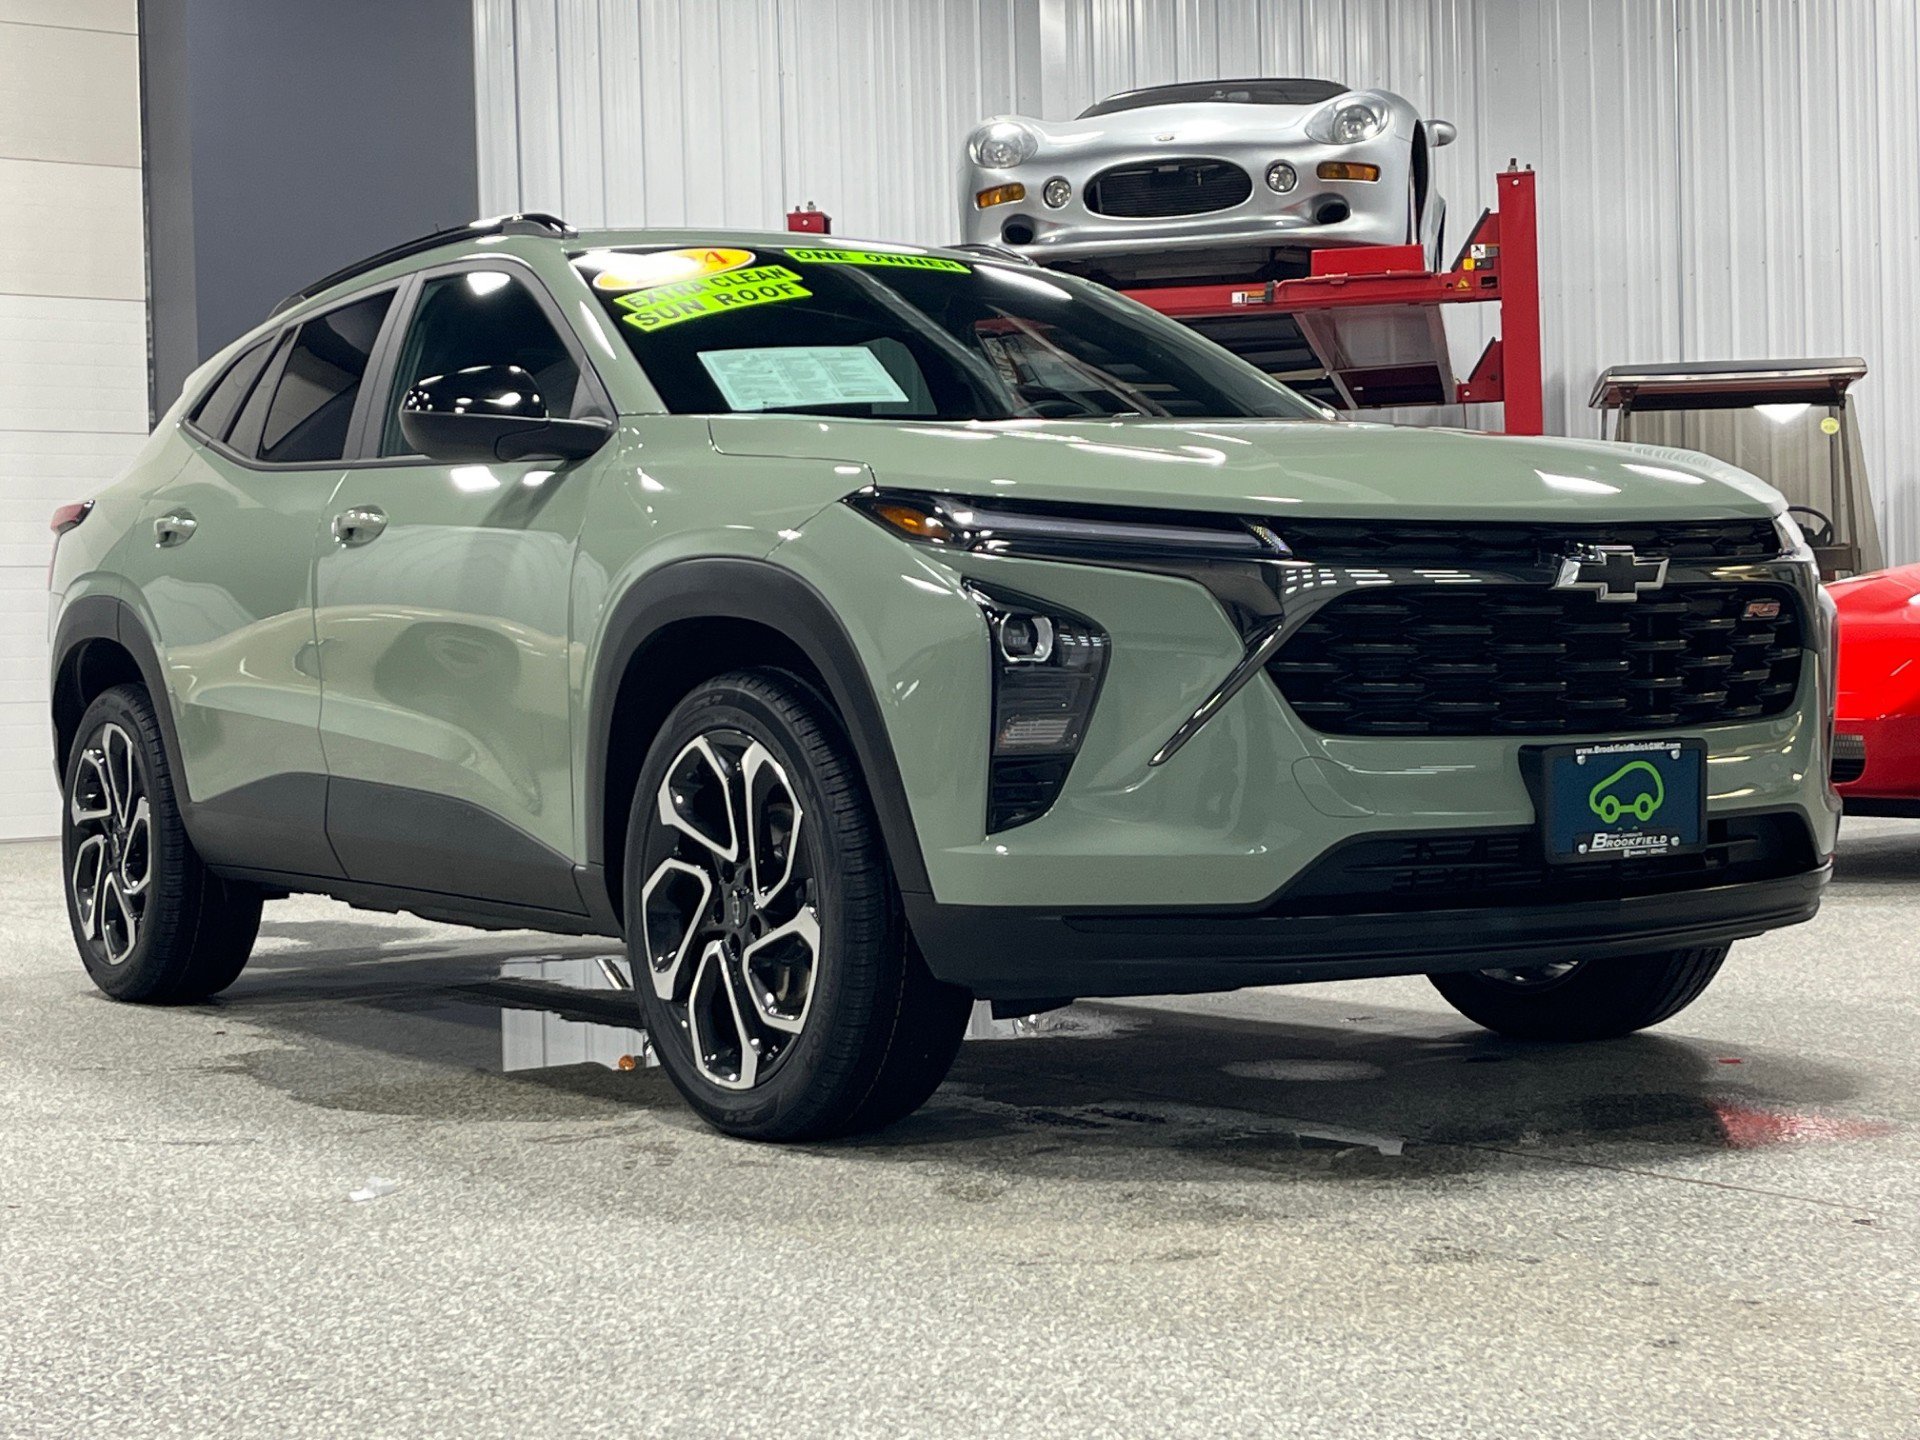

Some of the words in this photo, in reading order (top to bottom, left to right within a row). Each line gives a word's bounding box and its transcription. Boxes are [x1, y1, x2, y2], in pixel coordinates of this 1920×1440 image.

[795, 250, 849, 261] ONE
[864, 253, 961, 269] OWNER
[626, 280, 710, 308] EXTRA
[709, 267, 789, 288] CLEAN
[635, 299, 707, 326] SUN
[713, 283, 796, 306] ROOF
